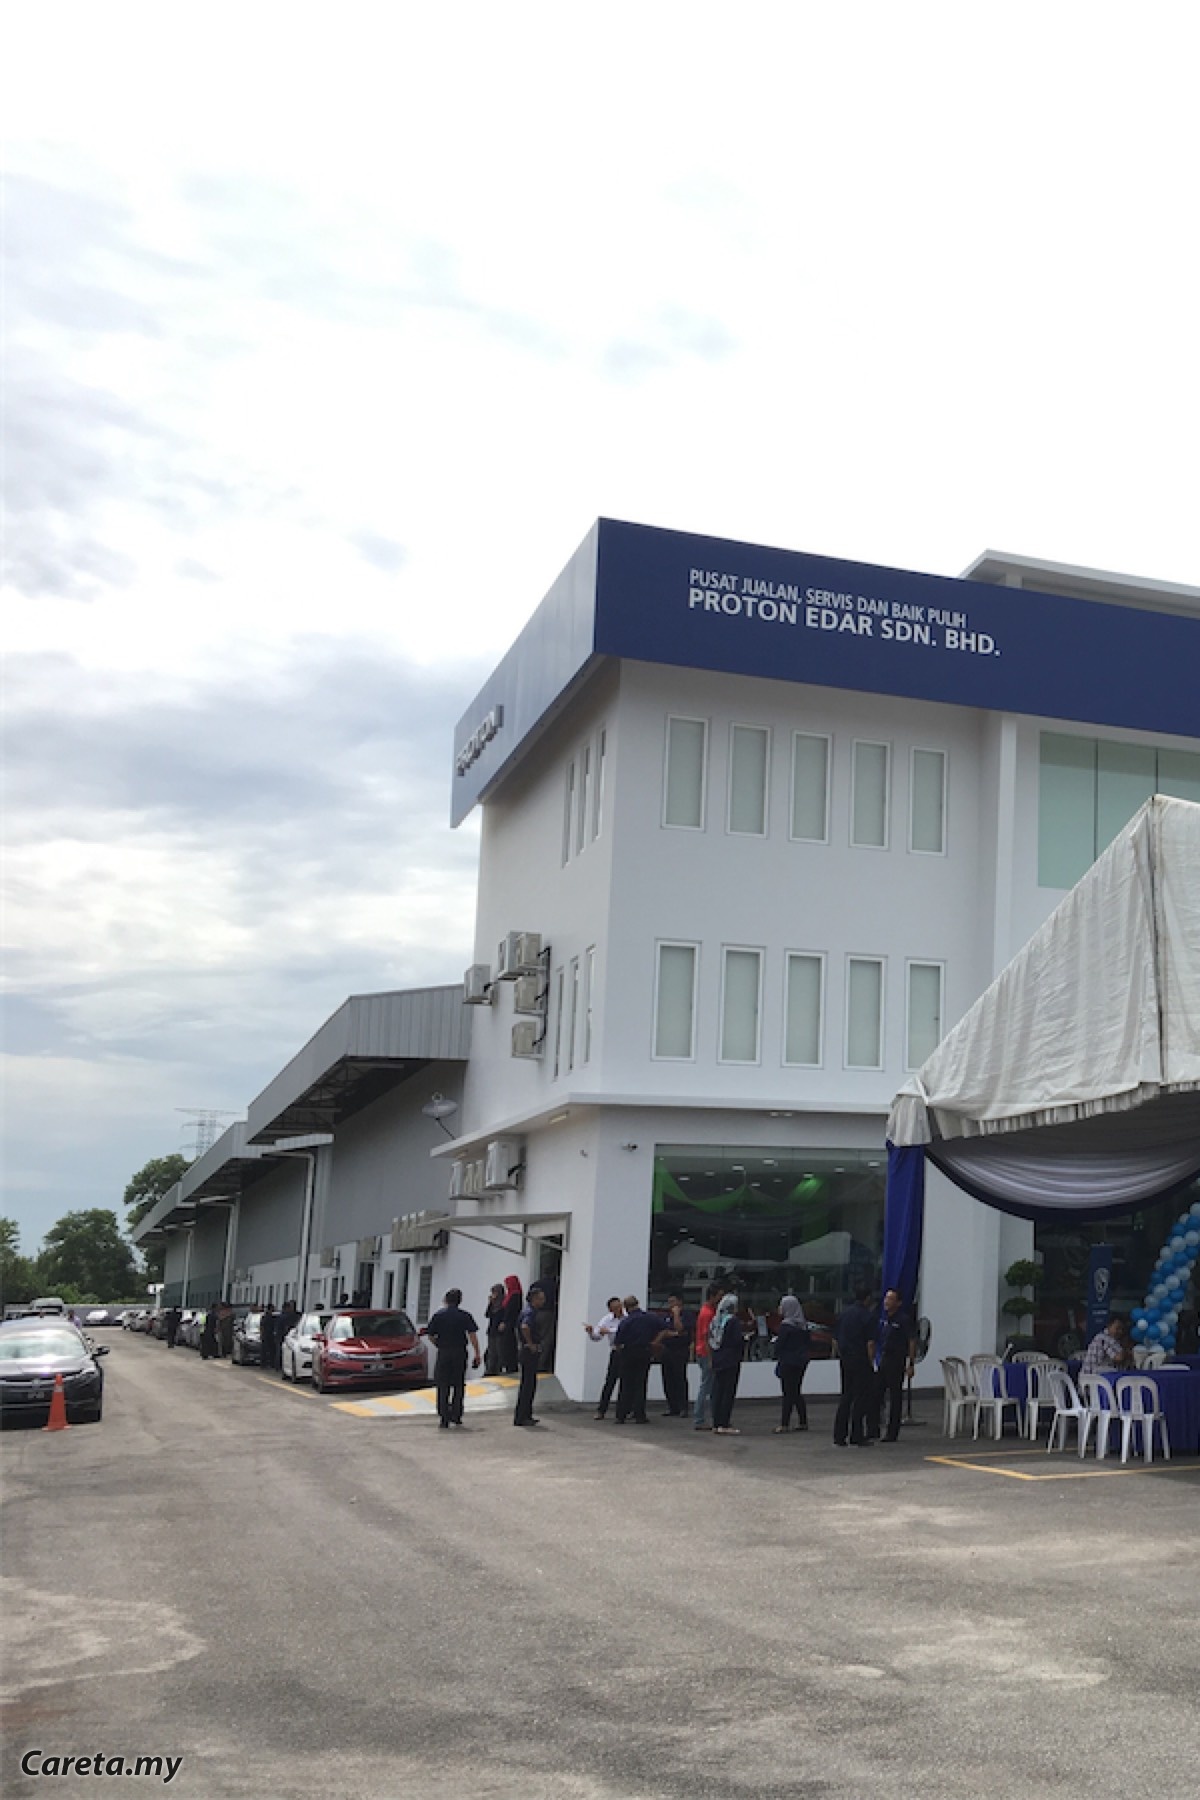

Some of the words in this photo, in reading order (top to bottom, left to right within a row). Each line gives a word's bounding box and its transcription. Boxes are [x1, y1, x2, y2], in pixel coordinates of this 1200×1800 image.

[689, 568, 738, 593] PUSAT
[741, 576, 802, 604] JUALAN,
[805, 587, 853, 611] SERVIS
[857, 597, 888, 617] DAN
[891, 602, 924, 623] BAIK
[927, 607, 967, 629] PULIH
[689, 587, 797, 625] PROTON
[805, 607, 873, 637] EDAR
[880, 619, 937, 648] SDN.
[944, 629, 1001, 657] BHD.
